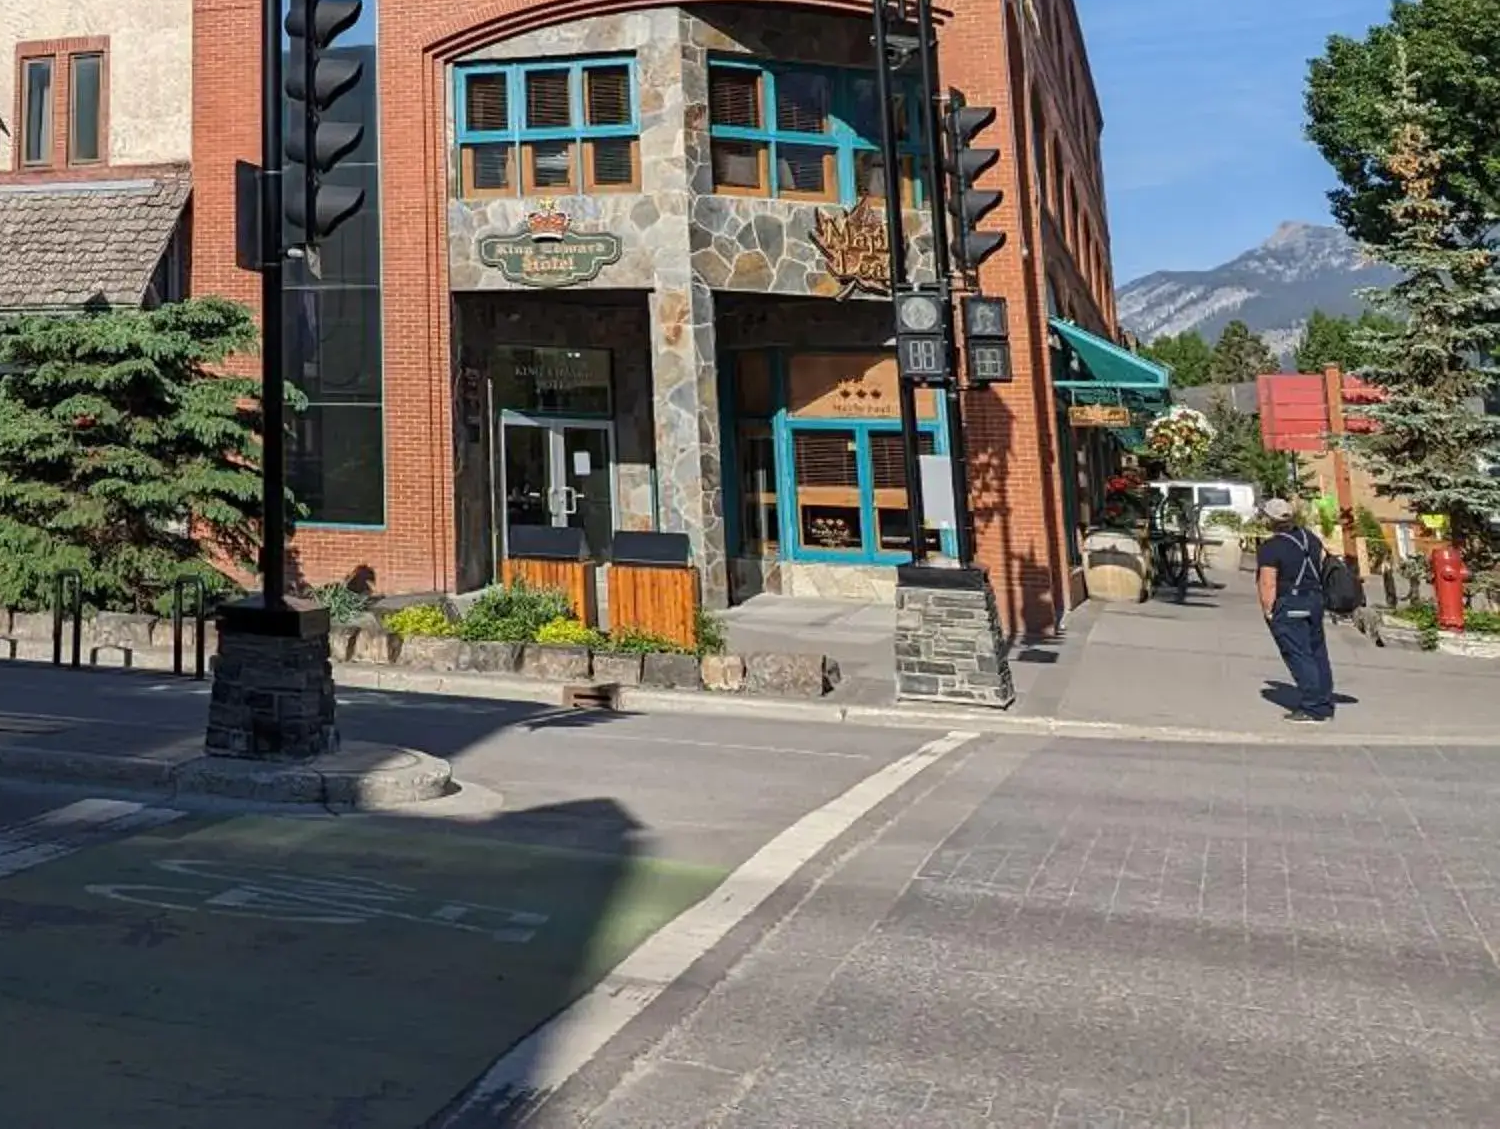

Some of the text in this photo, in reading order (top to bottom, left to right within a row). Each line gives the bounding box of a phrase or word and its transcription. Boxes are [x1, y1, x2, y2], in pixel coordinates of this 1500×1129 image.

[495, 242, 534, 257] King
[822, 218, 891, 256] Mapl
[521, 254, 575, 274] Hotel
[833, 249, 891, 280] Lea
